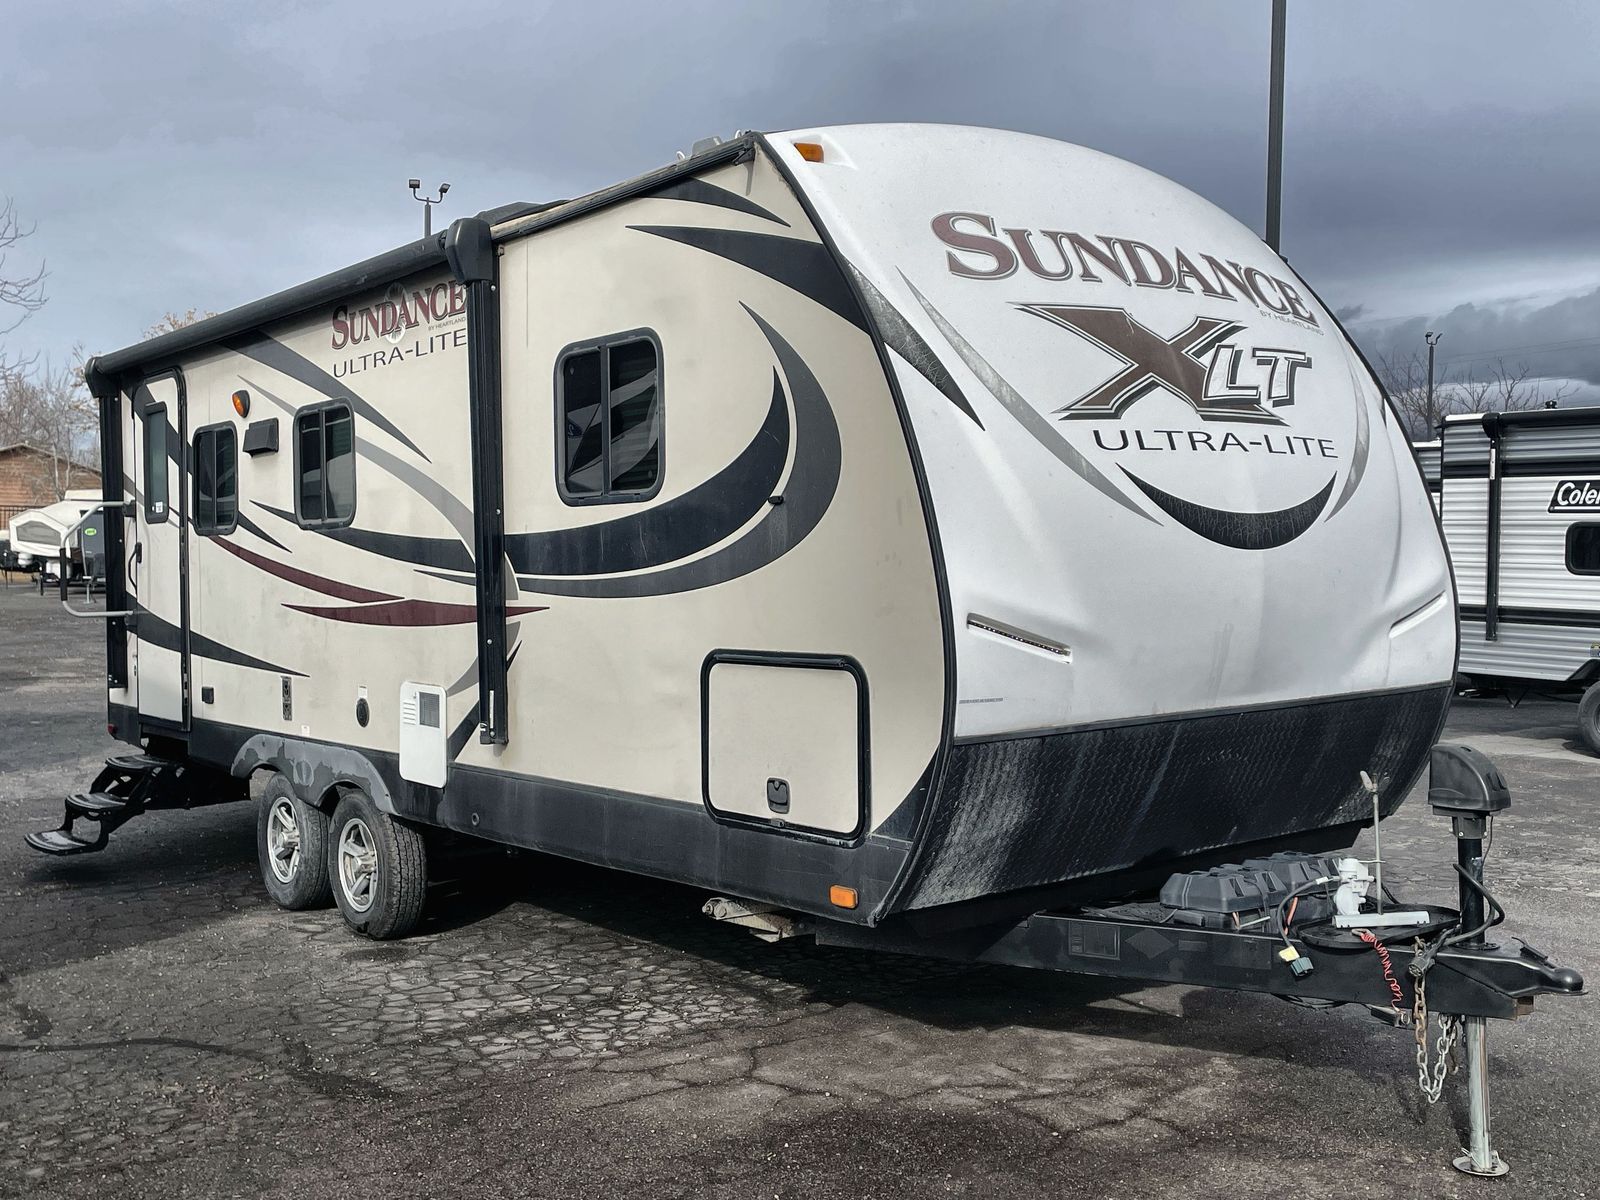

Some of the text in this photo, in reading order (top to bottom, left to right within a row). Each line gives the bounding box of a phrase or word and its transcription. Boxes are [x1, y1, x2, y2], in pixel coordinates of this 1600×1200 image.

[931, 211, 1319, 328] SUNDANCE
[332, 280, 467, 349] SUNDANCE
[435, 317, 466, 329] HEARTLAND
[1274, 313, 1324, 336] HEARTLAND
[333, 328, 467, 378] ULTRA-LITE
[1006, 303, 1312, 427] XLT
[1093, 429, 1338, 459] ULTRA-LITE
